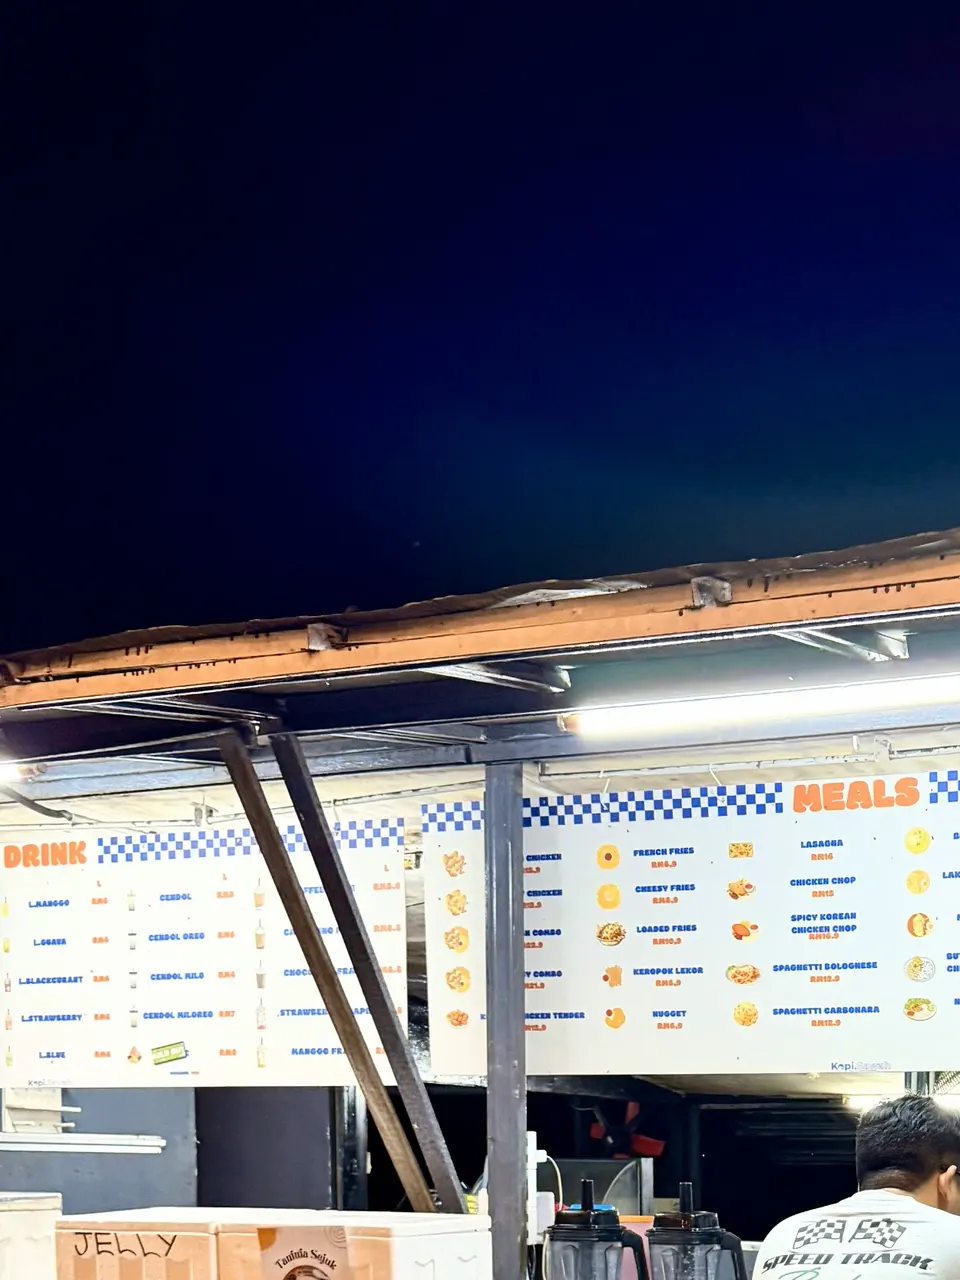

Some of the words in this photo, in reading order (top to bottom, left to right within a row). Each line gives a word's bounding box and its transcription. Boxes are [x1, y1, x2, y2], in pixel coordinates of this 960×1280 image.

[792, 778, 920, 813] MEALS
[801, 840, 843, 848] LASAGNA
[4, 841, 87, 868] DRINK
[790, 878, 829, 886] CHICKEN
[635, 885, 668, 893] CHEESY
[820, 912, 857, 920] KOREAN
[791, 926, 830, 934] CHICKEN
[773, 964, 822, 972] SPAGHETTI
[824, 962, 877, 970] BOLOGNESE
[824, 1006, 880, 1014] CARBONARA
[74, 1232, 177, 1257] JELLY
[311, 1250, 337, 1271] Sejuk
[761, 1253, 834, 1273] SPEED
[841, 1252, 933, 1270] TRACK
